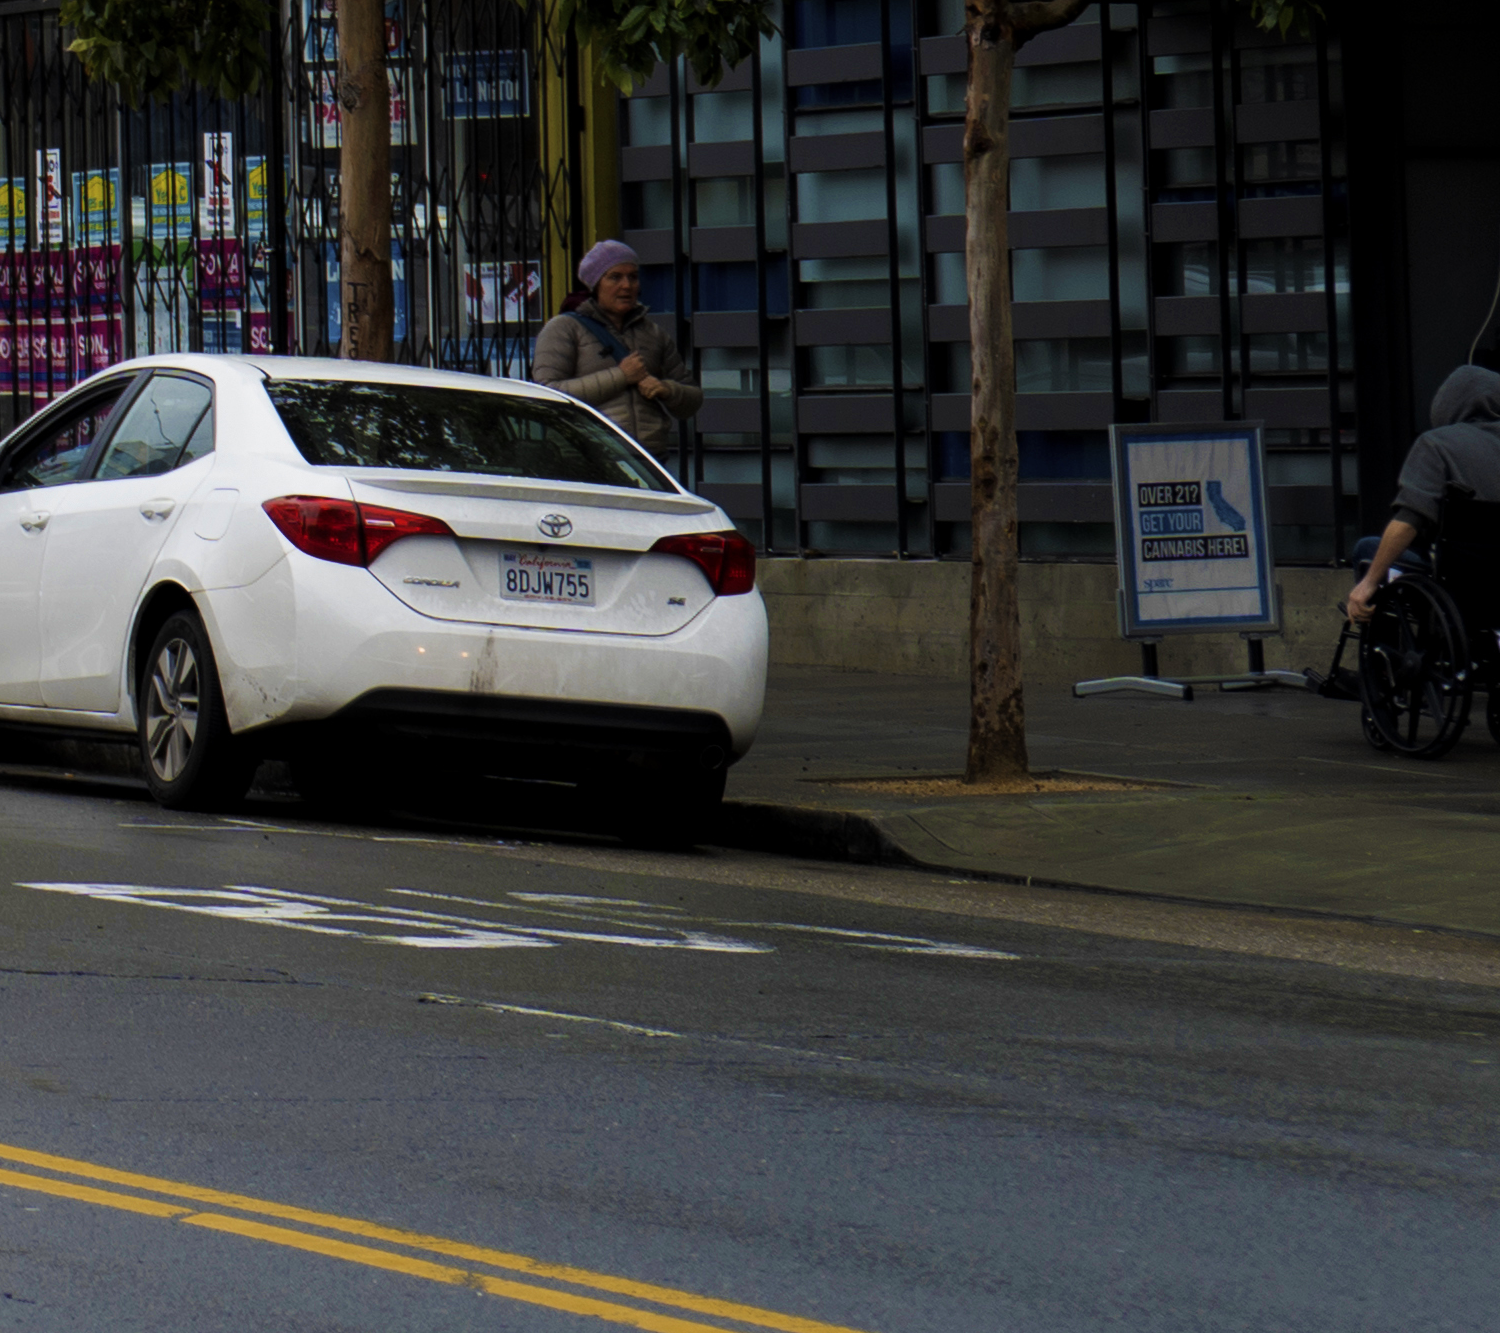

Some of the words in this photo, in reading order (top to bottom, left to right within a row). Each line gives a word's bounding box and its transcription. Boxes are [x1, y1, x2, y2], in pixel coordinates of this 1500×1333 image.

[1140, 485, 1173, 505] OVER
[1174, 484, 1199, 503] 21?
[1141, 513, 1166, 532] GET
[1167, 512, 1201, 532] YOUR
[1143, 538, 1206, 559] CANNABIS
[1207, 537, 1246, 556] HERE!
[518, 553, 576, 569] California
[506, 568, 590, 598] 8DJW755
